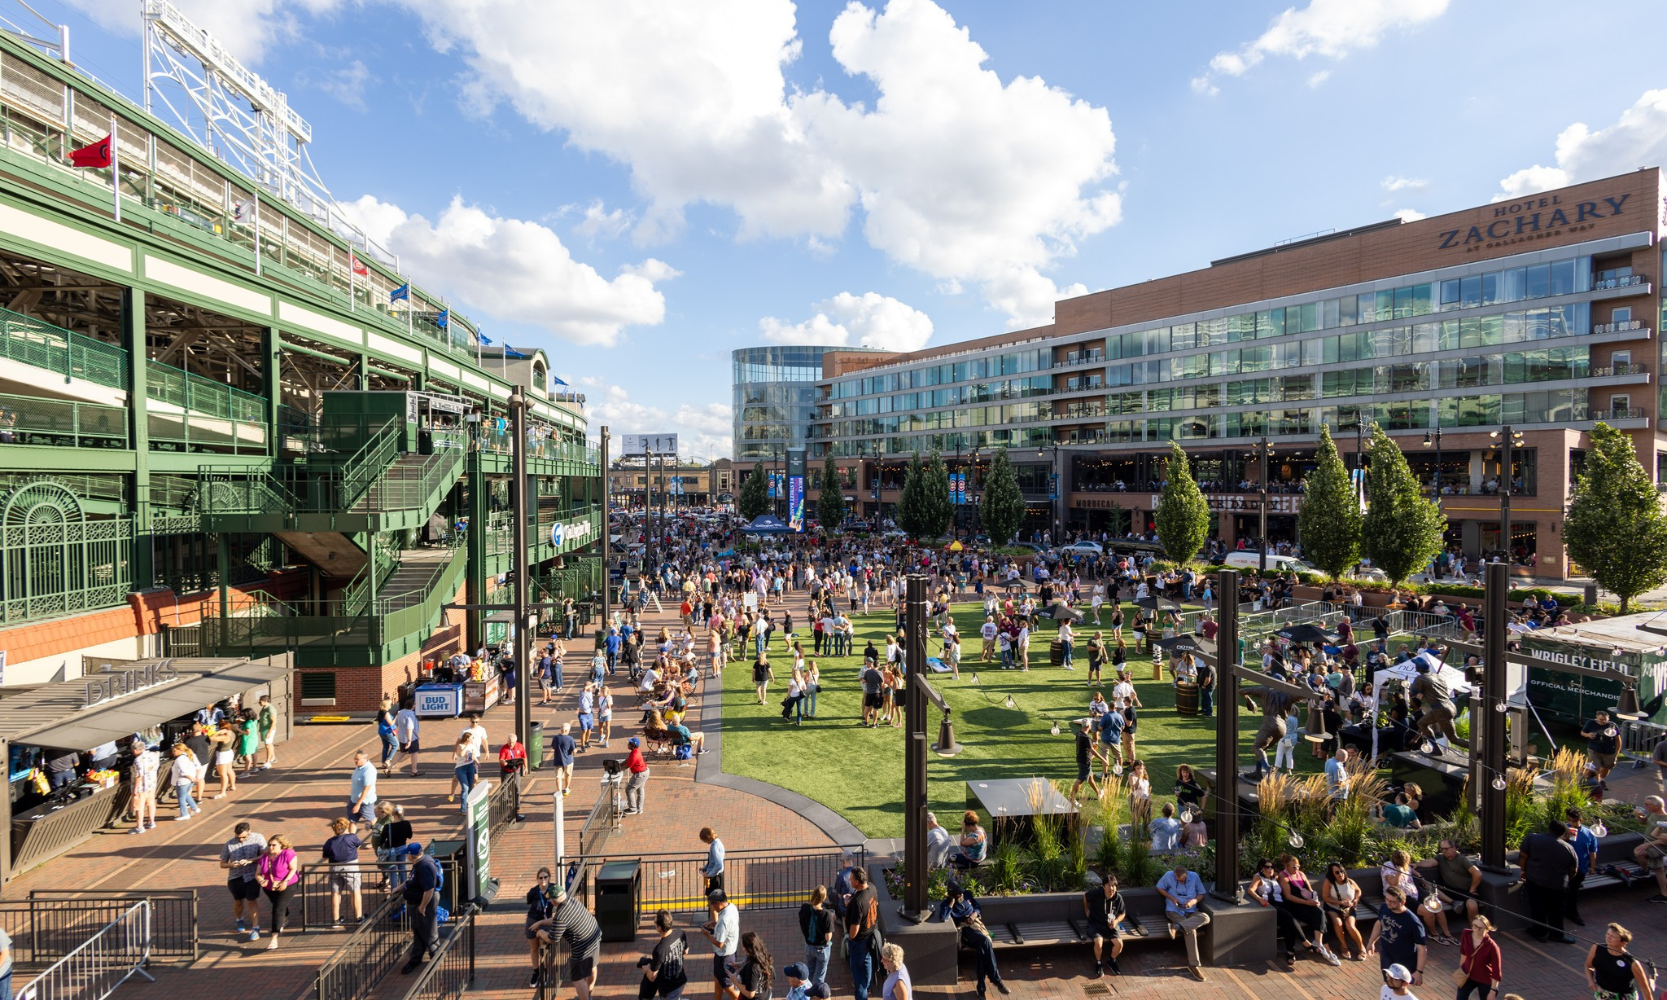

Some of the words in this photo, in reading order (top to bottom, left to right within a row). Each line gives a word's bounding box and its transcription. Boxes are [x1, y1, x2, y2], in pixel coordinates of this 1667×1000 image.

[1494, 195, 1562, 217] HOTEL
[1438, 193, 1631, 249] ZACHARY
[1466, 244, 1480, 253] AT
[1486, 229, 1561, 248] GALLAGHER
[1569, 223, 1595, 234] WAY
[1076, 499, 1114, 508] MORDECAI
[1272, 496, 1304, 513] BEE
[1531, 649, 1587, 668] WRIGLEY
[85, 658, 178, 706] DRINKS
[1530, 679, 1565, 691] OFFICIAL
[1568, 687, 1621, 701] MERCHANDIS
[421, 703, 449, 711] LIGHT
